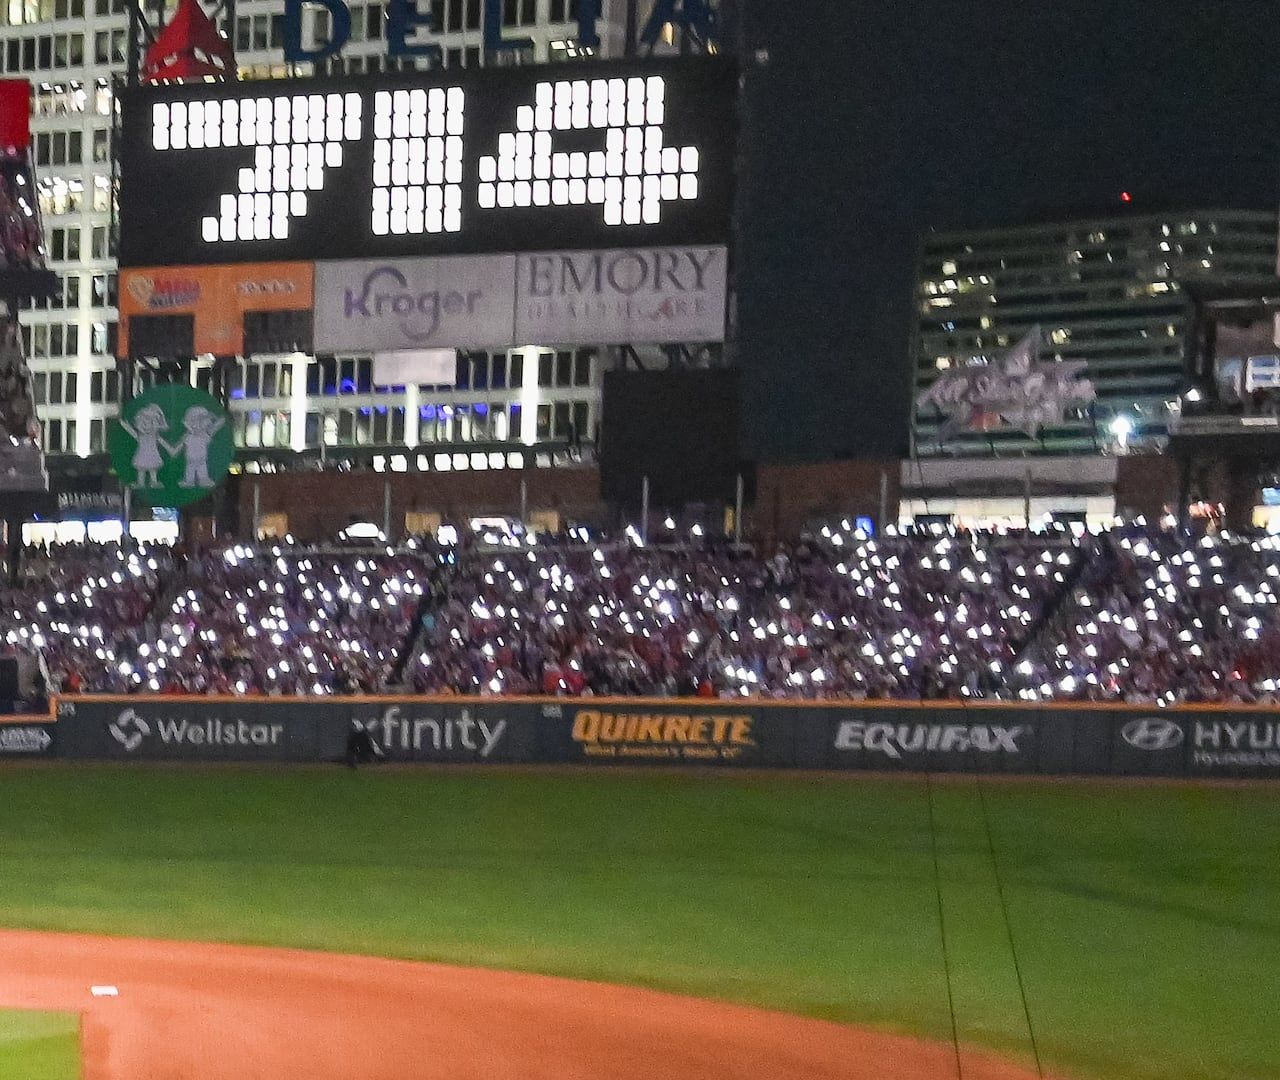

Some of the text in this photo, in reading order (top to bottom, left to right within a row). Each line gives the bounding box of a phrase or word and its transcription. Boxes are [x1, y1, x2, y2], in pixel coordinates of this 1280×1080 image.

[152, 75, 700, 242] 714
[527, 248, 720, 298] EMORY
[343, 267, 485, 341] Kroger
[157, 716, 284, 747] Wellstar
[571, 710, 755, 746] QUIKRETE
[833, 720, 1028, 758] EQUIFAX
[1194, 720, 1280, 749] HYU
